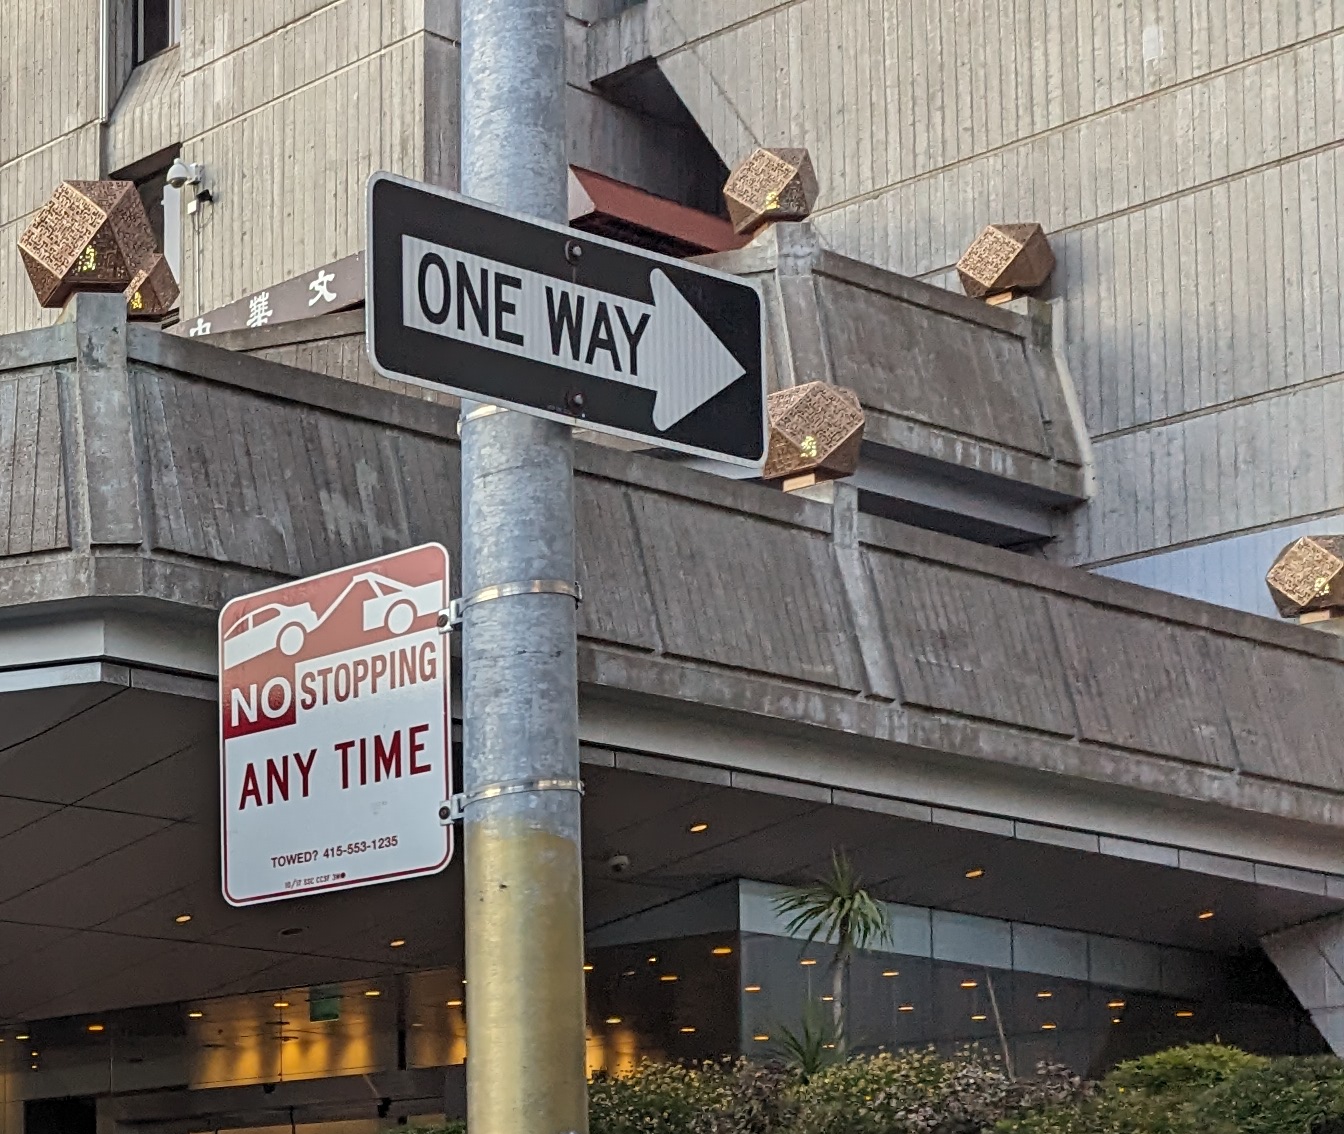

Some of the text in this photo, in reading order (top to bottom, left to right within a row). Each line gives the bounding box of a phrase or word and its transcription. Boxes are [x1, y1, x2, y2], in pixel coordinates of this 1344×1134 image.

[418, 252, 651, 376] ONE WAY
[231, 641, 437, 728] NO STOPPING
[238, 723, 432, 810] ANY TIME
[271, 835, 399, 868] TOWED? 415-553-1235
